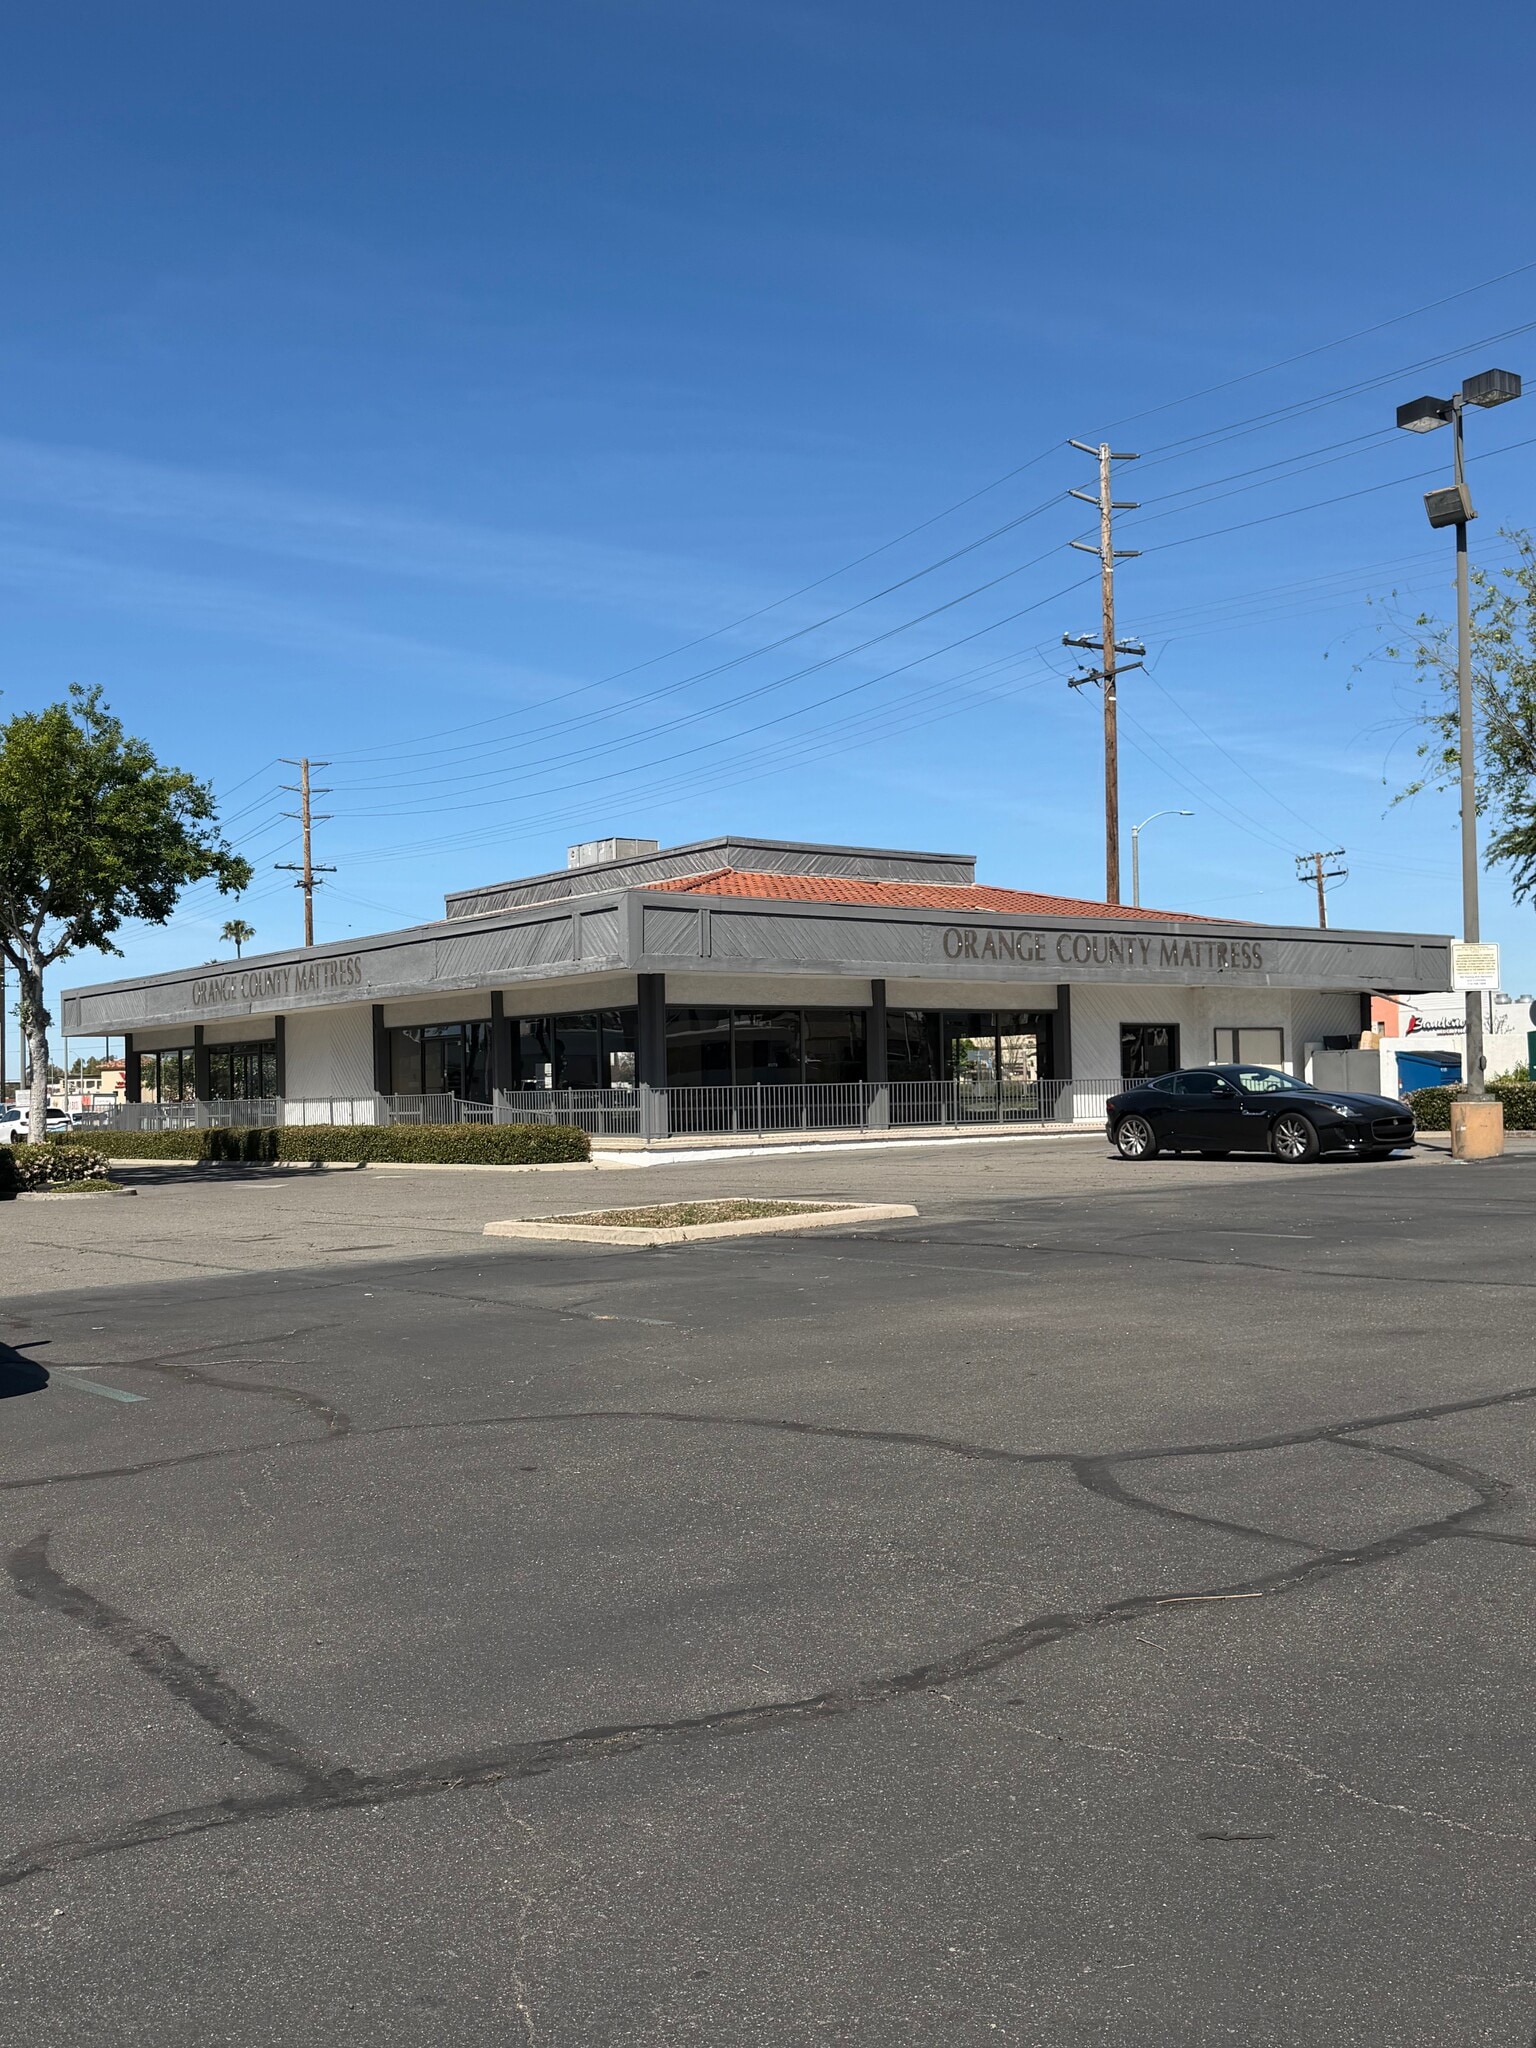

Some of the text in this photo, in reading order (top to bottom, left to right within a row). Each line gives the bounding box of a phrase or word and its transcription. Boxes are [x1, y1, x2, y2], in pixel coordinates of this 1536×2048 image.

[943, 927, 1264, 970] ORANGE COUNTY MATTRESS
[192, 957, 362, 1006] ORANGE COUNTY MATTRESS
